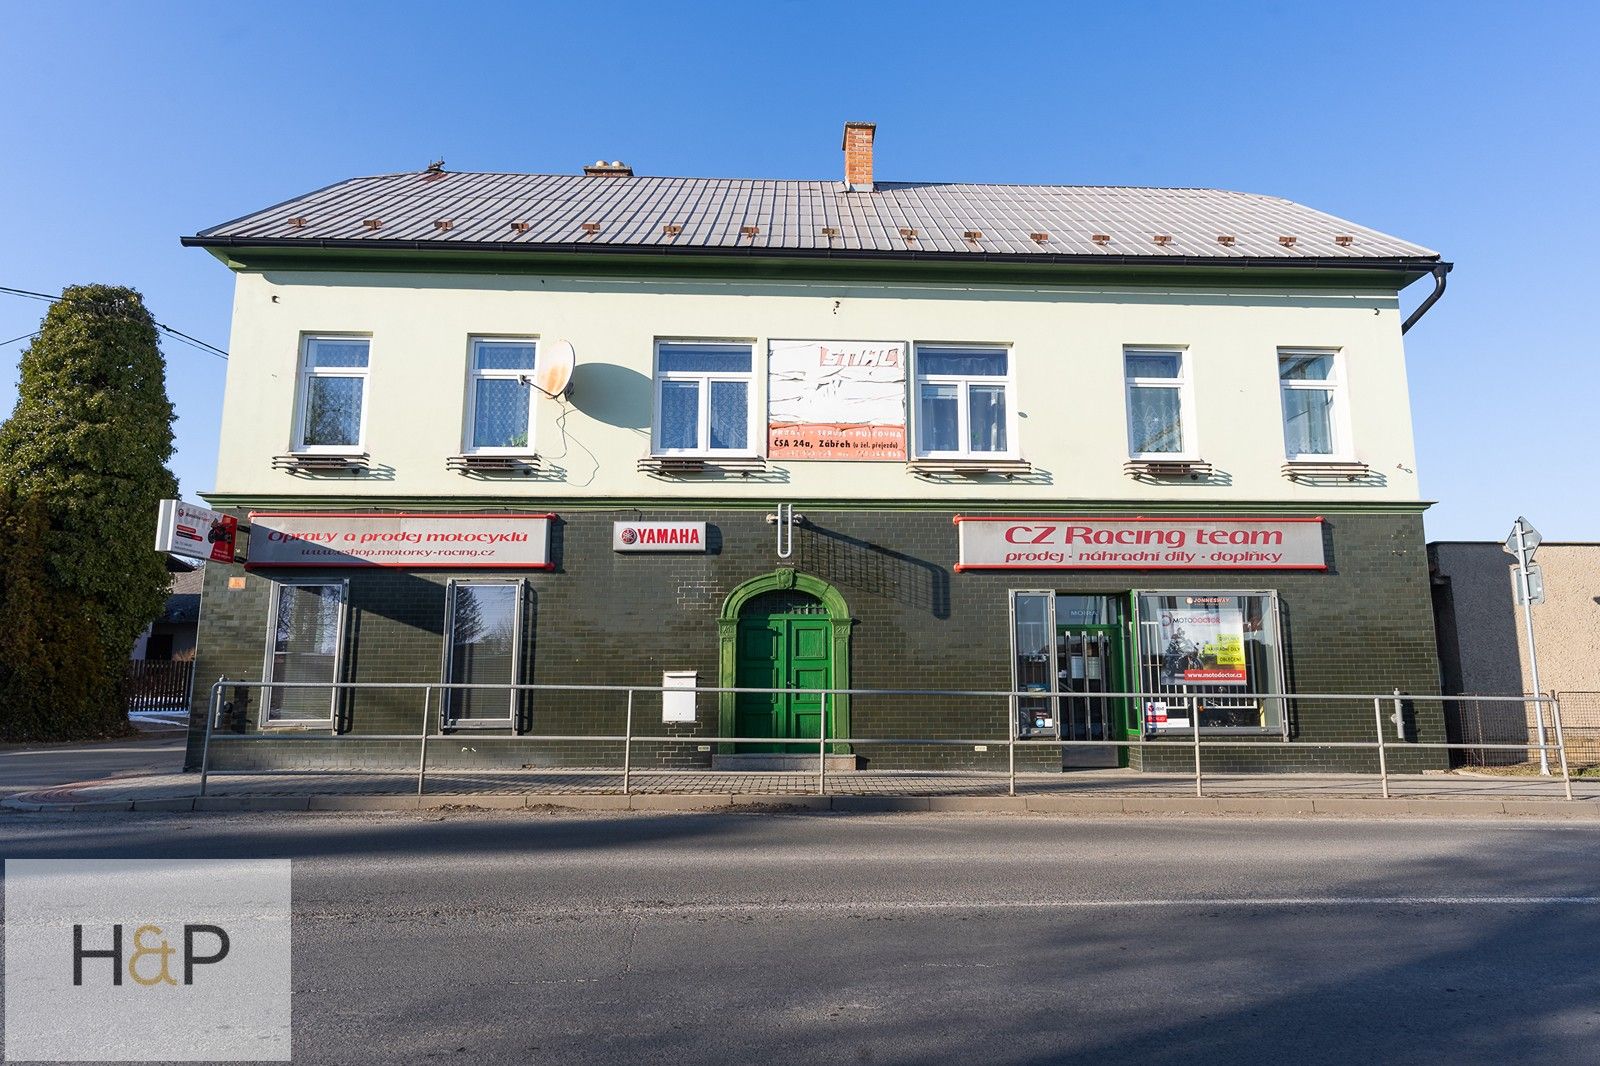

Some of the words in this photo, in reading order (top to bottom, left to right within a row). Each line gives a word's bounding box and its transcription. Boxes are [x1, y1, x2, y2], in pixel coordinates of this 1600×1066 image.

[774, 437, 790, 447] ČSA
[793, 439, 814, 449] 24a,
[818, 439, 851, 448] Zábřeh
[268, 530, 338, 543] Opravy
[343, 532, 356, 542] a
[360, 531, 422, 544] prodej
[426, 531, 529, 544] motocyklů
[638, 528, 700, 544] YAMAHA
[1004, 526, 1057, 545] CZ
[1064, 526, 1186, 549] Racing
[1196, 529, 1283, 545] team
[301, 548, 496, 557] www.eshop.motorky-racing.cz
[1005, 551, 1064, 563] prodej
[1079, 551, 1161, 562] náhradní
[1164, 551, 1196, 563] díly
[1210, 551, 1283, 563] doplňky
